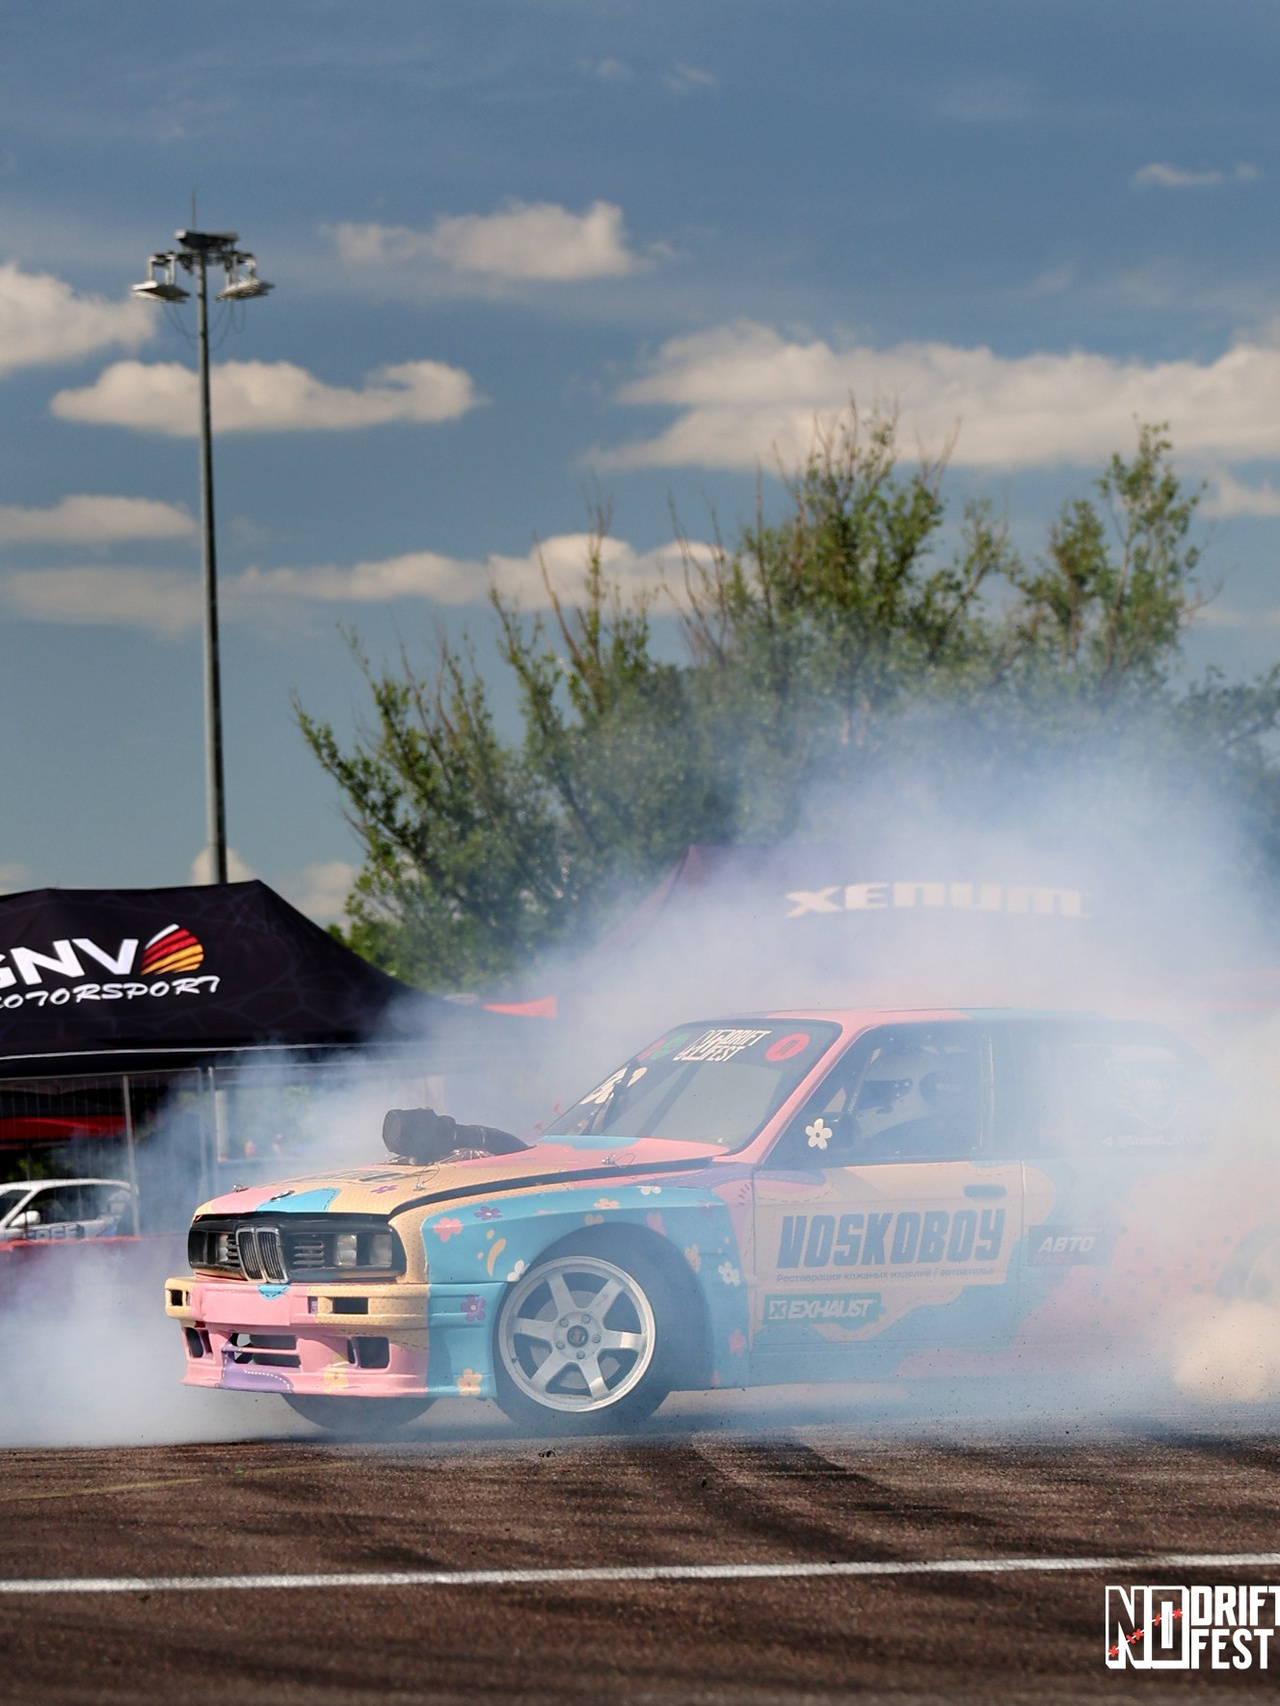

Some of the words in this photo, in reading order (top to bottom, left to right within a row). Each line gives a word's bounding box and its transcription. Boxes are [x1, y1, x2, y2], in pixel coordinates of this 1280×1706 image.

[0, 938, 139, 989] NV
[0, 975, 220, 1009] OTORSPORT
[700, 1044, 746, 1062] FEST
[777, 1209, 1005, 1269] VOSKOBOY
[788, 1299, 874, 1319] EXHAUST
